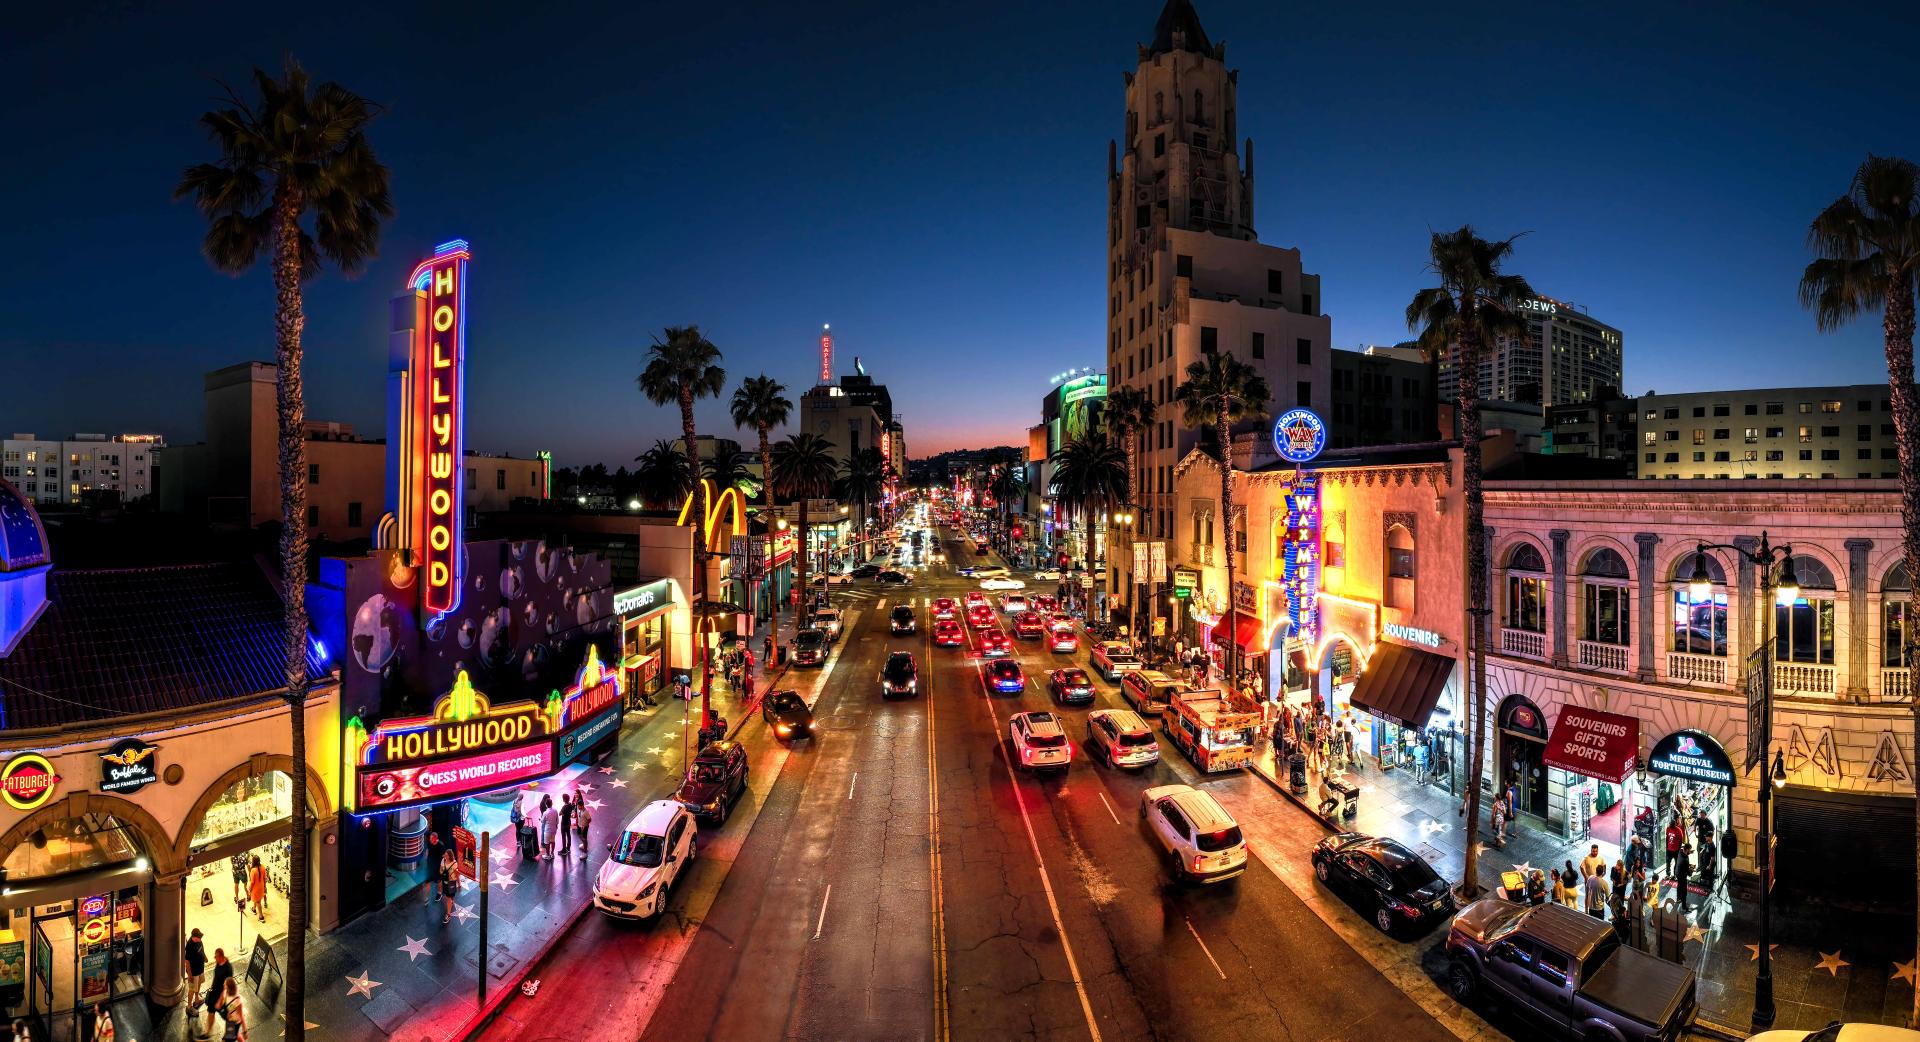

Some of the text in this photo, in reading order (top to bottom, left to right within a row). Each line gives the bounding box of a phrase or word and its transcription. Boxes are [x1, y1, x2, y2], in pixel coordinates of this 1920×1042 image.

[431, 267, 455, 588] HOLLYWOOD
[1278, 412, 1321, 430] HOLLYWOOD
[1288, 427, 1314, 441] WAX
[1294, 495, 1312, 641] WAX MUSEUM
[1383, 623, 1440, 648] SOUVENIRS
[572, 681, 614, 721] HOLLYWOOD
[1565, 715, 1627, 737] SOUVENIRS
[387, 715, 532, 761] HOLLYWOOD
[1574, 731, 1607, 747] GIFTS
[1563, 742, 1607, 762] SPORTS
[1669, 753, 1712, 768] MEDIEVAL
[111, 765, 148, 780] Buffalo's
[458, 763, 496, 781] WORLD
[497, 753, 542, 773] RECORDS
[1652, 759, 1730, 781] TORTURE MUSEUM
[3, 773, 54, 790] FATBURGER
[103, 775, 156, 791] WORLD FAMOUS WINGS
[82, 899, 105, 913] OPEN
[117, 908, 135, 921] EBT
